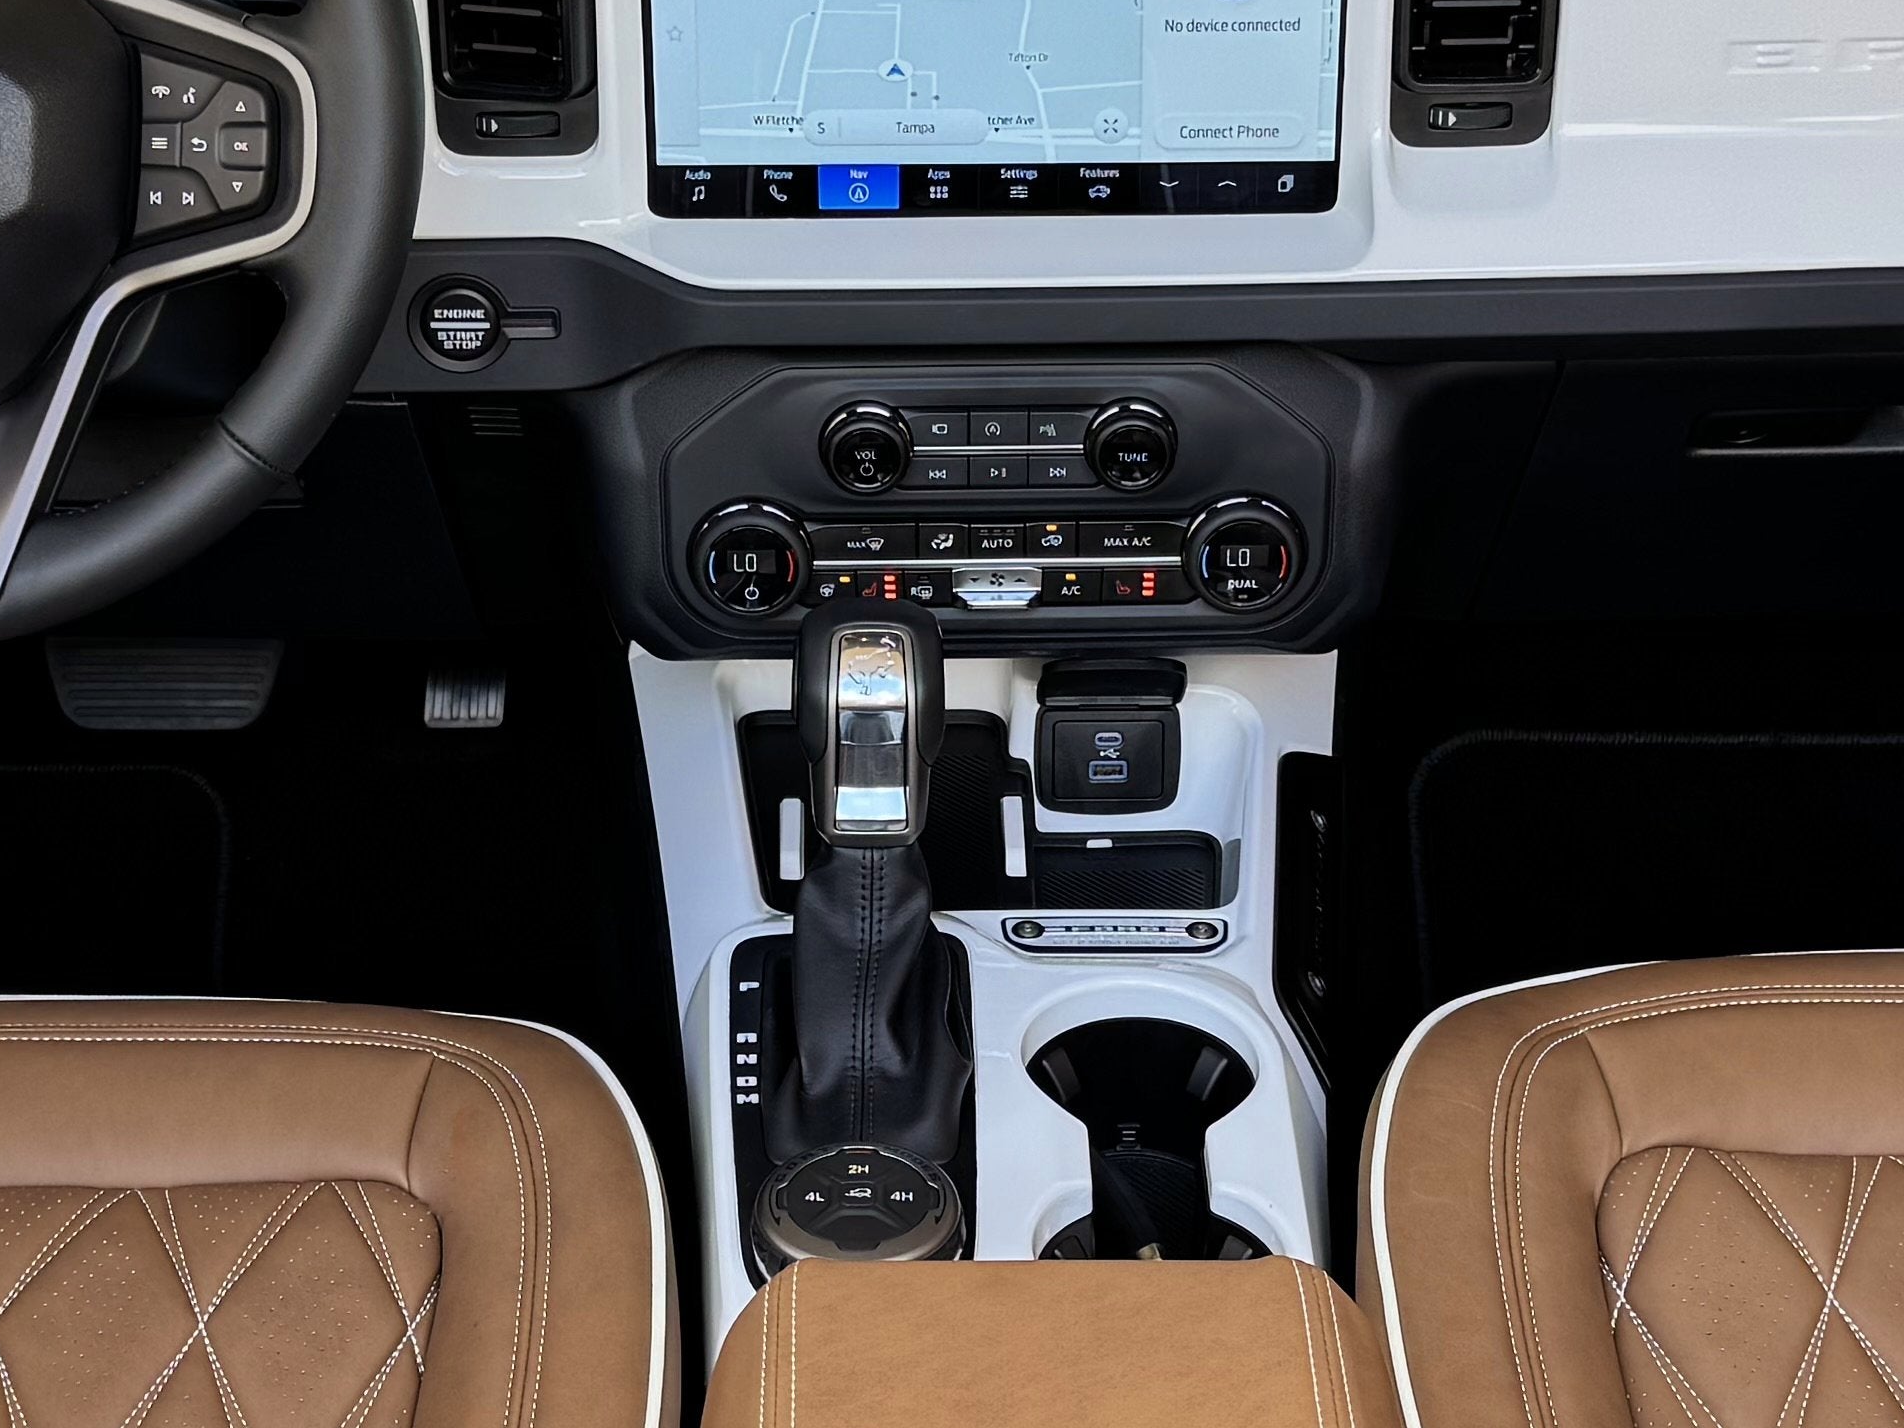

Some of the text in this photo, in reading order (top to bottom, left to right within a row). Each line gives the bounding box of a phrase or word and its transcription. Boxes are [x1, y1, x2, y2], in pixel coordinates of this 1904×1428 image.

[1165, 17, 1301, 33] No device connected
[753, 116, 764, 125] W
[1015, 116, 1035, 125] Ave
[817, 123, 825, 134] S
[896, 122, 935, 135] Tampa
[1180, 125, 1279, 139] Connect Phone
[234, 142, 248, 152] OK
[685, 170, 711, 180] Audio
[763, 170, 793, 180] Phone
[850, 170, 868, 179] Nav
[1000, 168, 1038, 180] Settings
[1080, 168, 1119, 178] Features
[433, 309, 485, 319] ENGINE
[437, 331, 485, 341] START
[443, 341, 482, 350] STOP
[855, 450, 877, 460] VOL
[1118, 452, 1148, 462] TUNE
[982, 539, 1013, 549] AUTO
[1104, 536, 1152, 547] MAX A/C
[1226, 548, 1250, 567] LO
[733, 554, 757, 572] LO
[1227, 578, 1258, 590] DUAL
[1061, 585, 1081, 596] A/C
[739, 982, 760, 992] P
[736, 1054, 758, 1064] N
[736, 1076, 758, 1087] D
[736, 1093, 759, 1104] M
[848, 1164, 869, 1174] 2H
[805, 1192, 825, 1202] 4L
[890, 1192, 913, 1202] 4H
